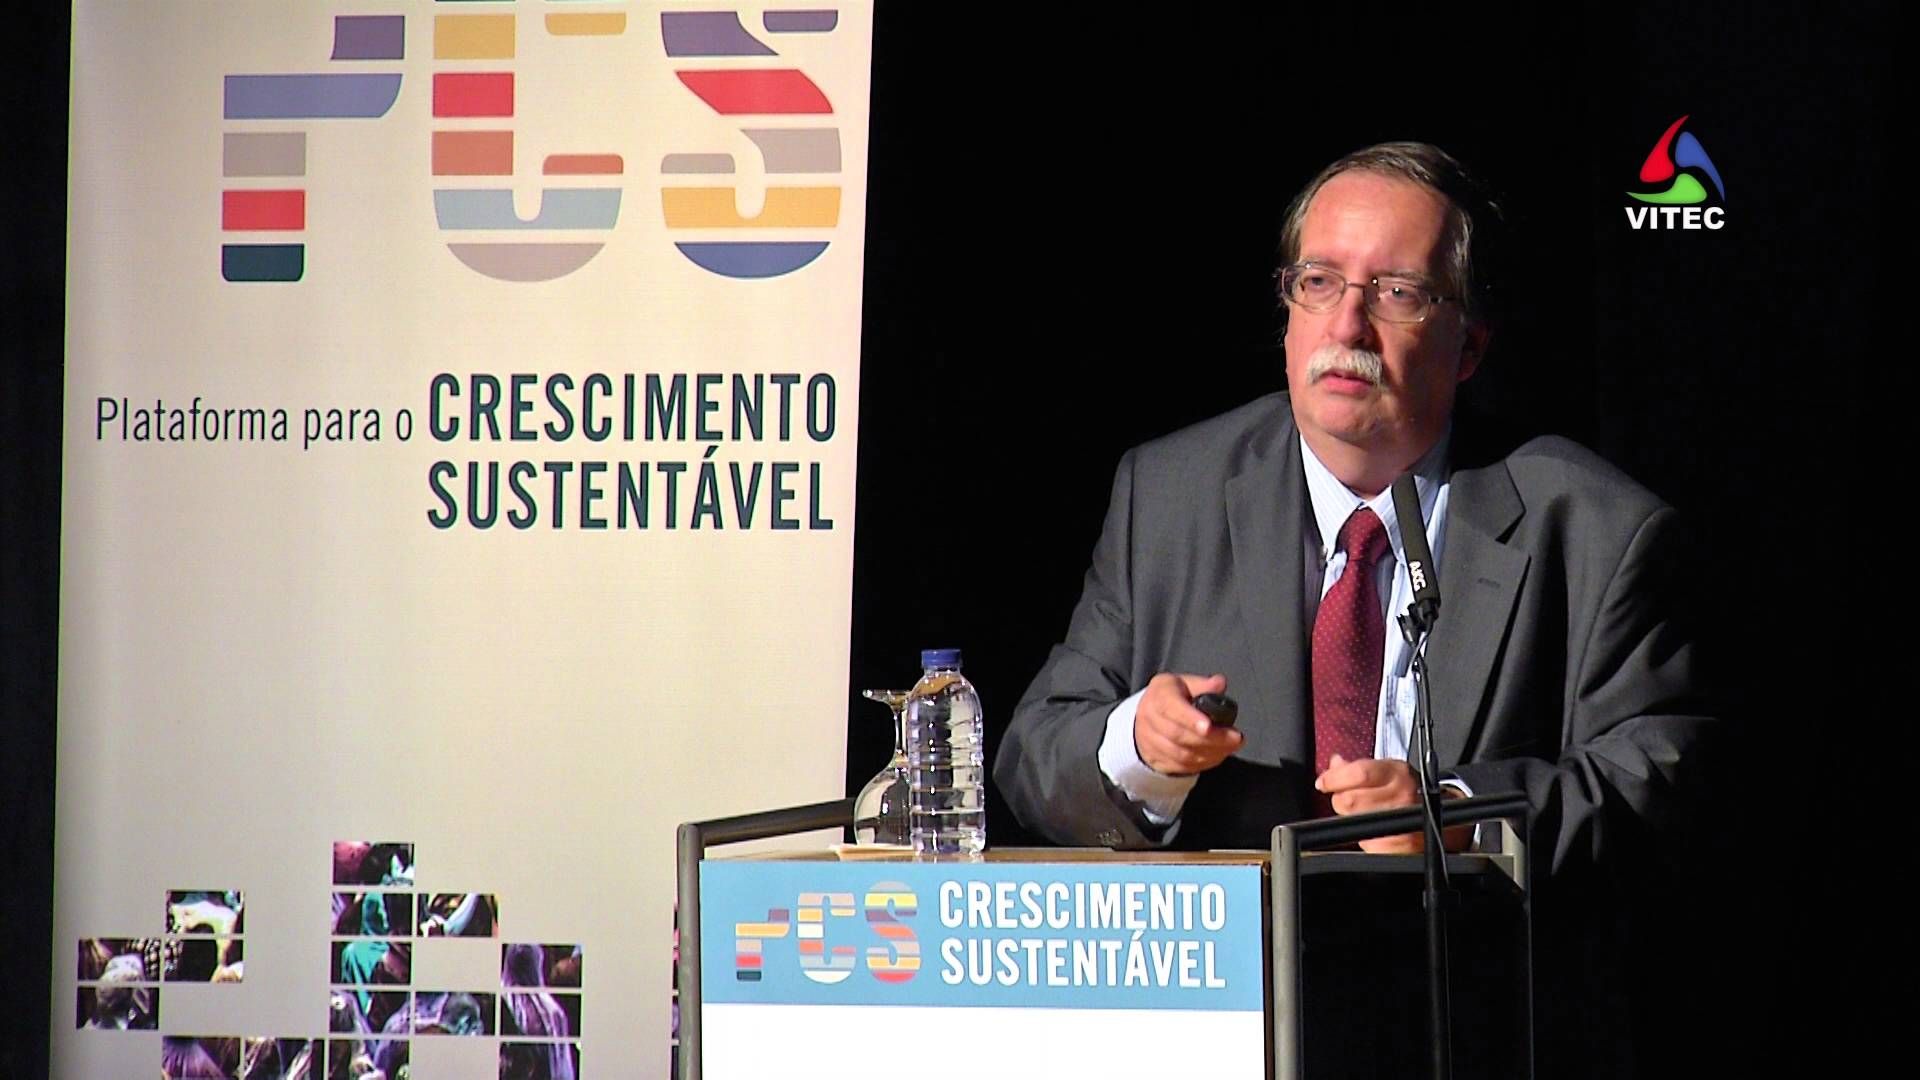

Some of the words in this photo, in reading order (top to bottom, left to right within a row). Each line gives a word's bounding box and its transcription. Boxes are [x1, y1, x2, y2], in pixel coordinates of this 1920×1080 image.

[96, 397, 289, 442] Plataforma
[303, 408, 382, 450] para
[395, 408, 413, 441] o
[429, 373, 837, 442] CRESCIMENTO
[428, 446, 834, 530] SUSTENTÁVEL
[939, 881, 1226, 930] CRESCIMENTO
[941, 930, 1226, 988] SUSTENTÁVEL
